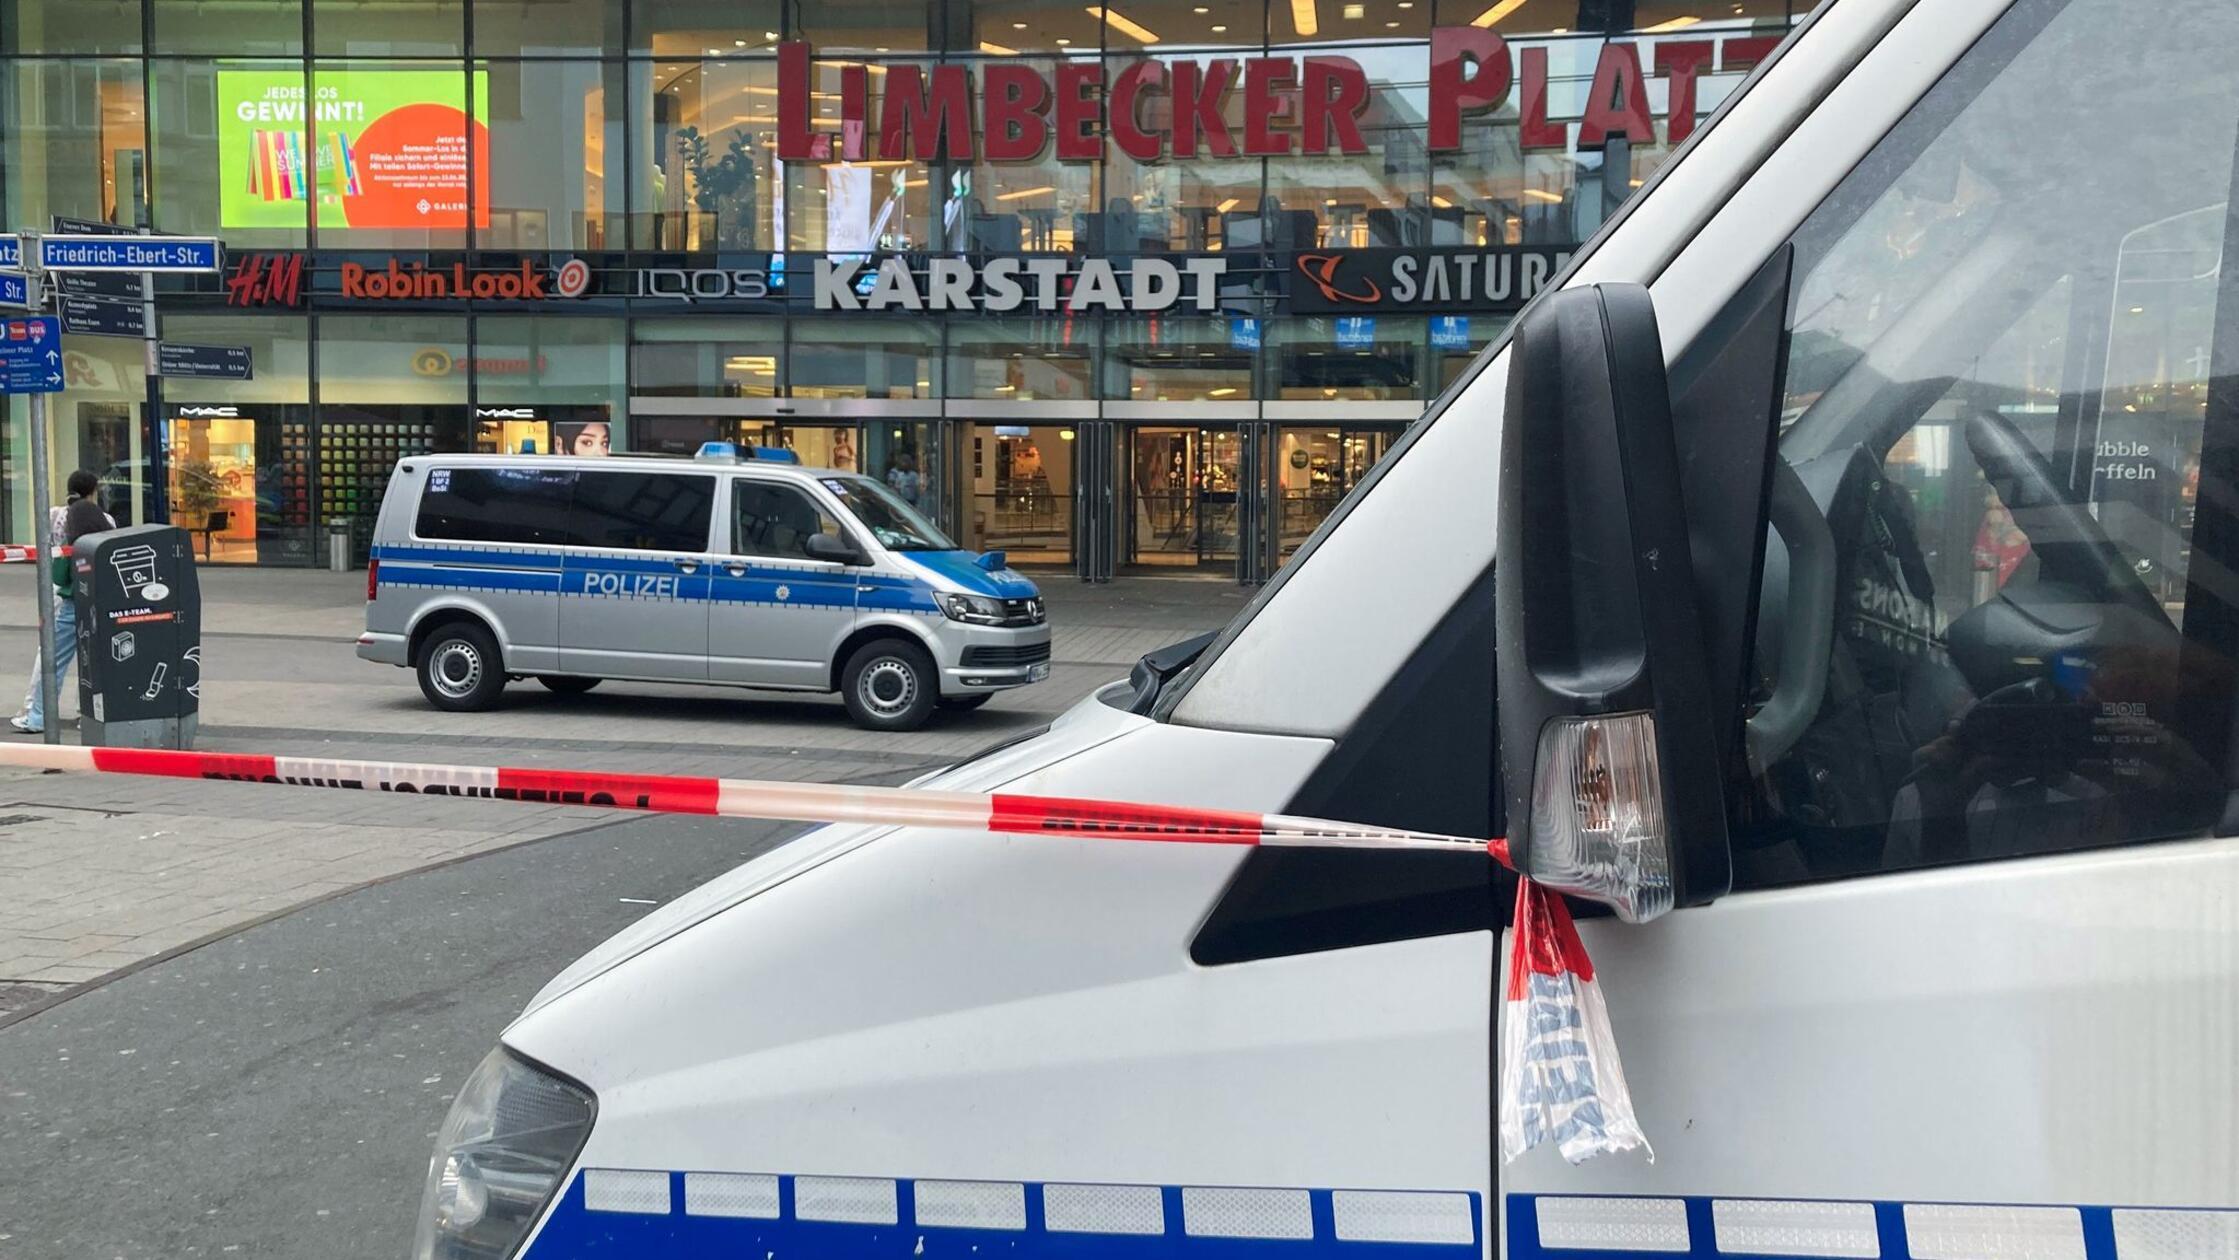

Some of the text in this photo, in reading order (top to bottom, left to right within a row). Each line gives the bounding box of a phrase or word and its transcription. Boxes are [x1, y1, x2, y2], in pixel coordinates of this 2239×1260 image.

[263, 86, 338, 99] JEDES OS
[776, 40, 1371, 161] LIMBECKER
[407, 162, 466, 170] Sofort-Gewinne
[433, 202, 467, 211] GALERI
[0, 244, 19, 262] tz
[47, 244, 204, 264] Friedrich-Ebert-Str.
[227, 252, 304, 306] H&M
[341, 258, 545, 299] Robin Look
[638, 268, 768, 303] IQOS
[813, 256, 1227, 311] KARSTADT
[5, 280, 24, 300] Str.
[2094, 463, 2156, 480] ffeln
[584, 572, 679, 598] POLIZEI
[109, 611, 124, 619] DAS
